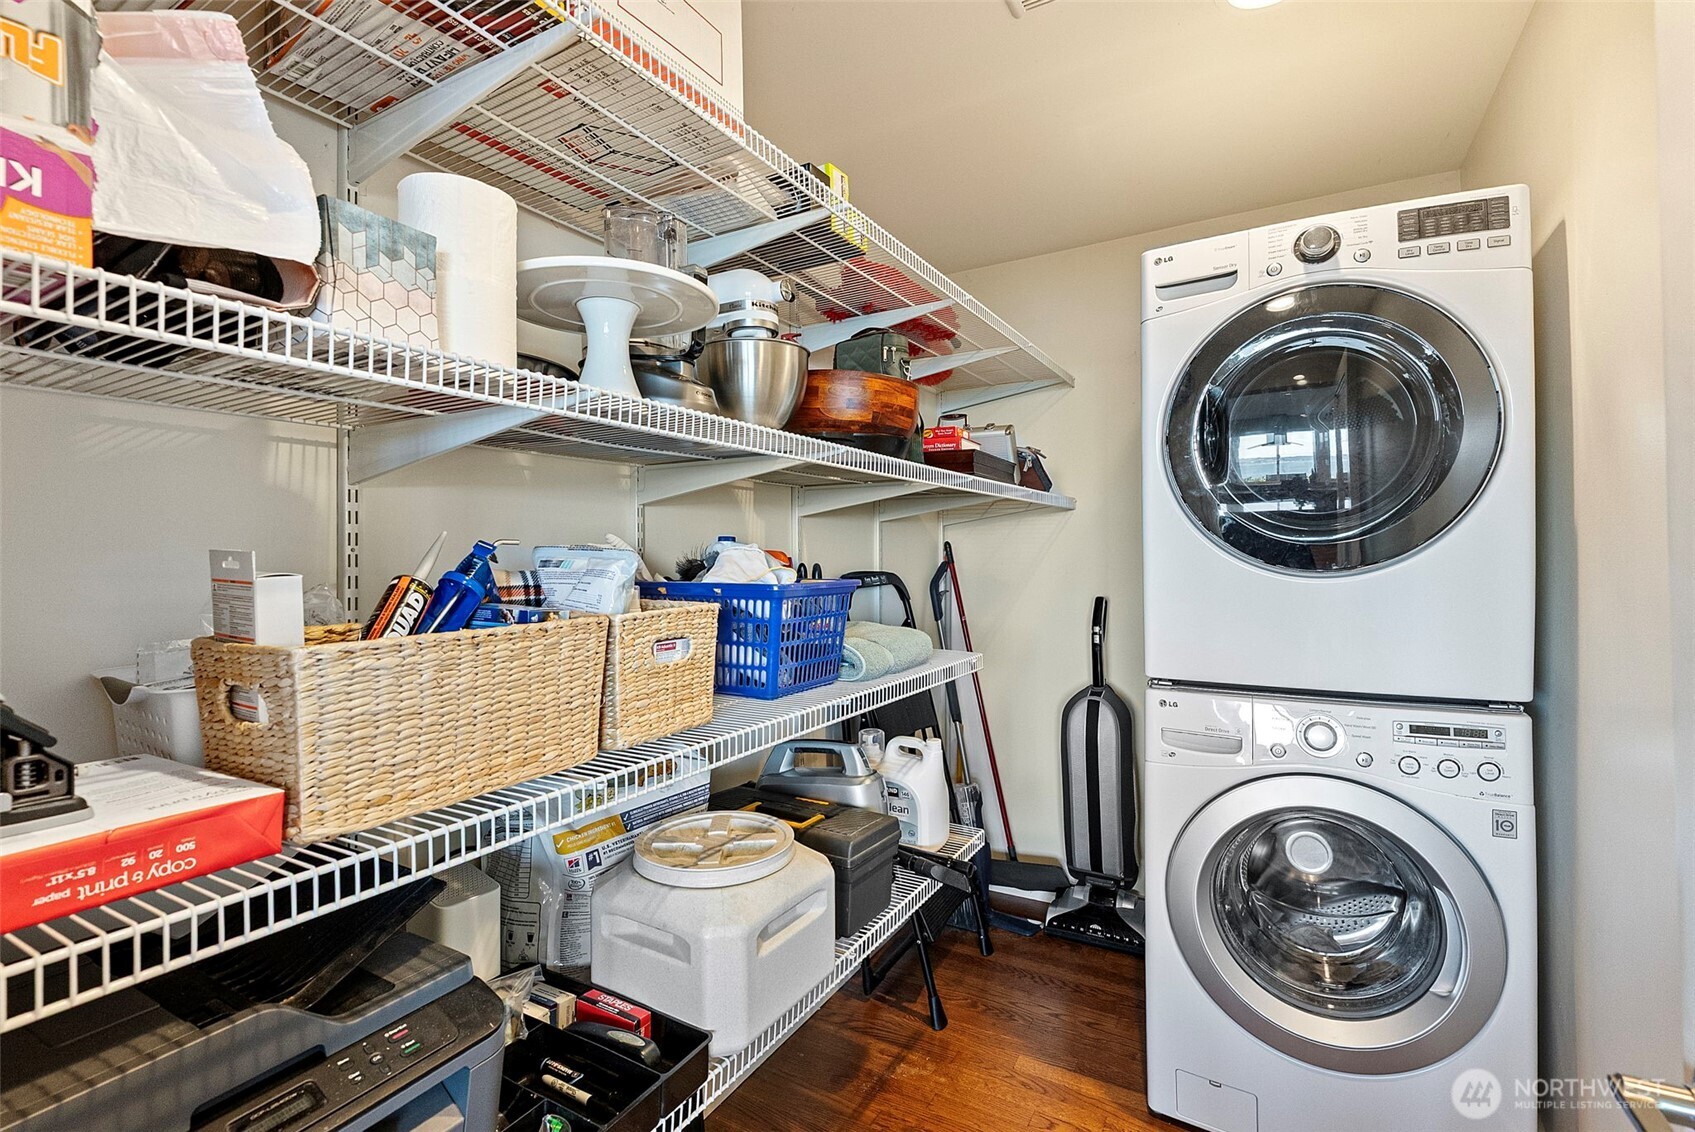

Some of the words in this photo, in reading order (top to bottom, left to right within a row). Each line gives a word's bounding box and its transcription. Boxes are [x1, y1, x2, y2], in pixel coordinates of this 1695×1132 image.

[1163, 255, 1174, 264] LG
[1204, 726, 1218, 734] Direct
[566, 832, 588, 844] CHICKEN
[587, 823, 612, 836] INGREDIENT
[148, 848, 164, 860] 20
[176, 841, 196, 853] 500
[601, 844, 612, 852] U.S.
[121, 856, 137, 868] 92
[588, 850, 600, 864] #1
[144, 857, 197, 880] copy
[131, 870, 144, 884] &
[77, 874, 130, 901] print
[31, 888, 72, 908] paper
[597, 993, 635, 1012] STAPLES
